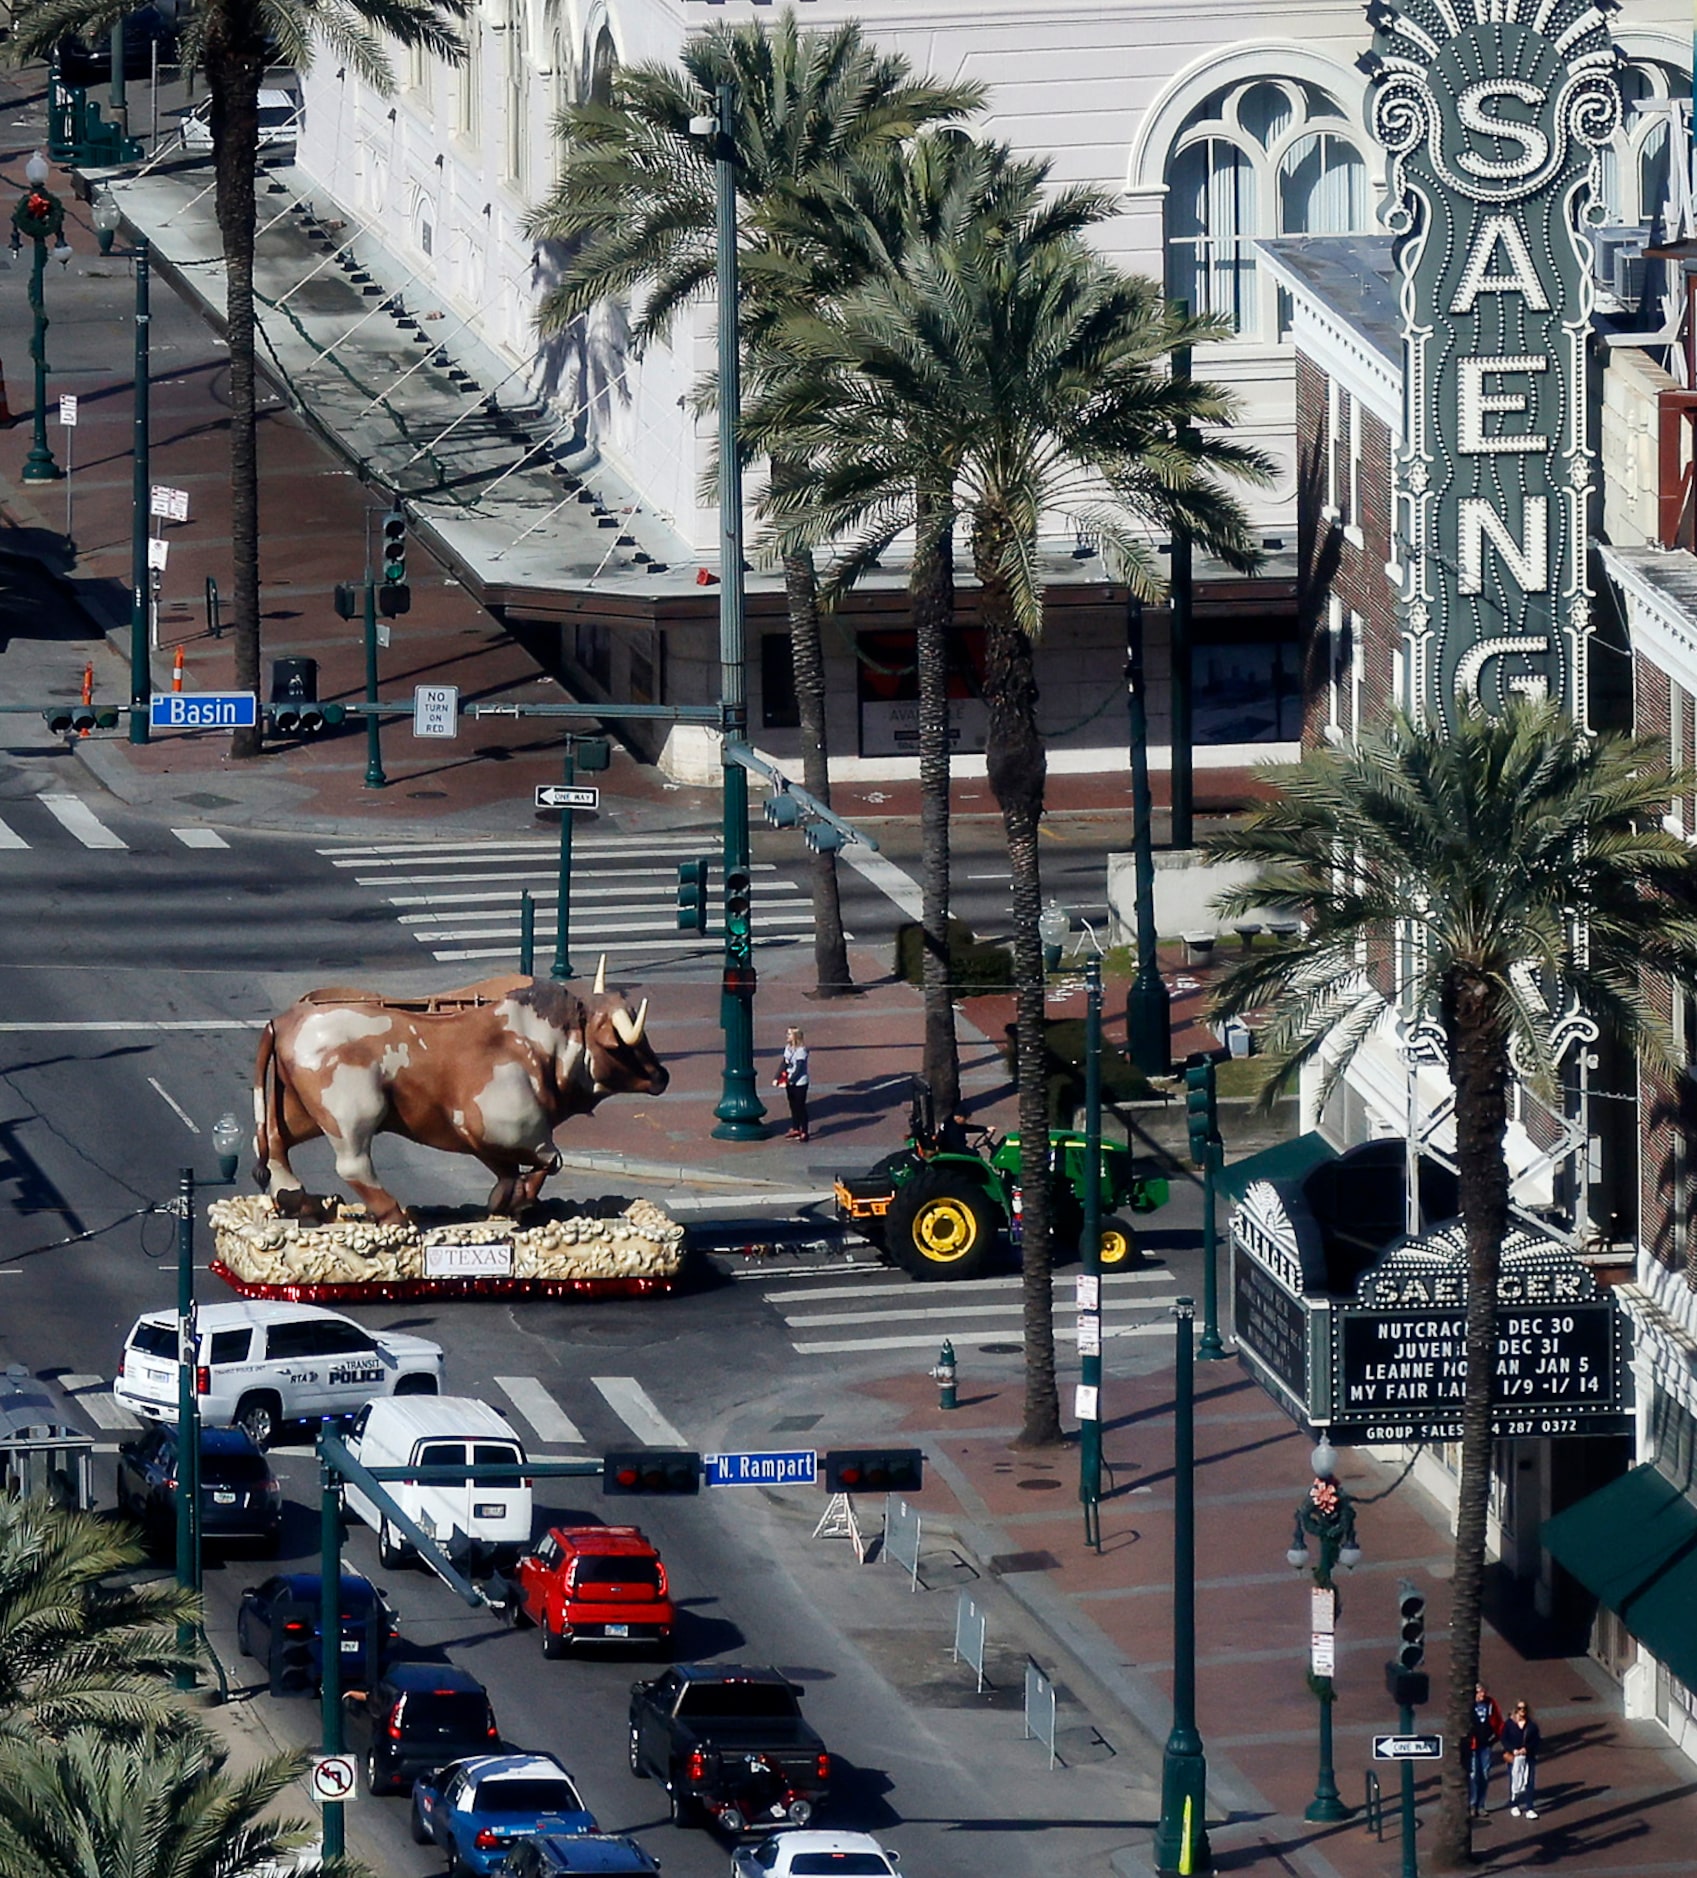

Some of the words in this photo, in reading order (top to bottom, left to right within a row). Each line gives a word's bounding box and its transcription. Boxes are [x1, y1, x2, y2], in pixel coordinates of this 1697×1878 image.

[427, 691, 445, 702] NO
[170, 698, 236, 724] Basin
[425, 703, 449, 712] TURN
[429, 714, 442, 722] ON
[426, 724, 444, 733] RED
[554, 793, 570, 801] ONE
[445, 1248, 508, 1266] TEXAS
[1375, 1274, 1580, 1303] SAEGER
[1378, 1321, 1499, 1340] NUTCRAC
[1508, 1318, 1543, 1336] DEC
[1550, 1316, 1574, 1334] 30
[1393, 1341, 1470, 1360] JUVENIL
[1498, 1339, 1532, 1355] DEC
[1540, 1338, 1559, 1355] 31
[346, 1359, 379, 1369] TRANSIT
[1365, 1362, 1434, 1380] LEANNE
[1535, 1357, 1570, 1374] JAN
[1578, 1356, 1589, 1373] 5
[290, 1373, 308, 1384] RTA
[329, 1369, 385, 1385] POLICE
[1350, 1384, 1376, 1402] MY
[1386, 1382, 1428, 1400] FAIR
[1503, 1379, 1534, 1396] 1/9
[1366, 1425, 1414, 1440] GROUP
[1420, 1423, 1465, 1438] SALES
[1508, 1421, 1533, 1434] 287
[1541, 1419, 1577, 1433] 0372
[719, 1457, 734, 1478] N.
[740, 1454, 812, 1482] Rampart
[1393, 1742, 1411, 1752] ONE
